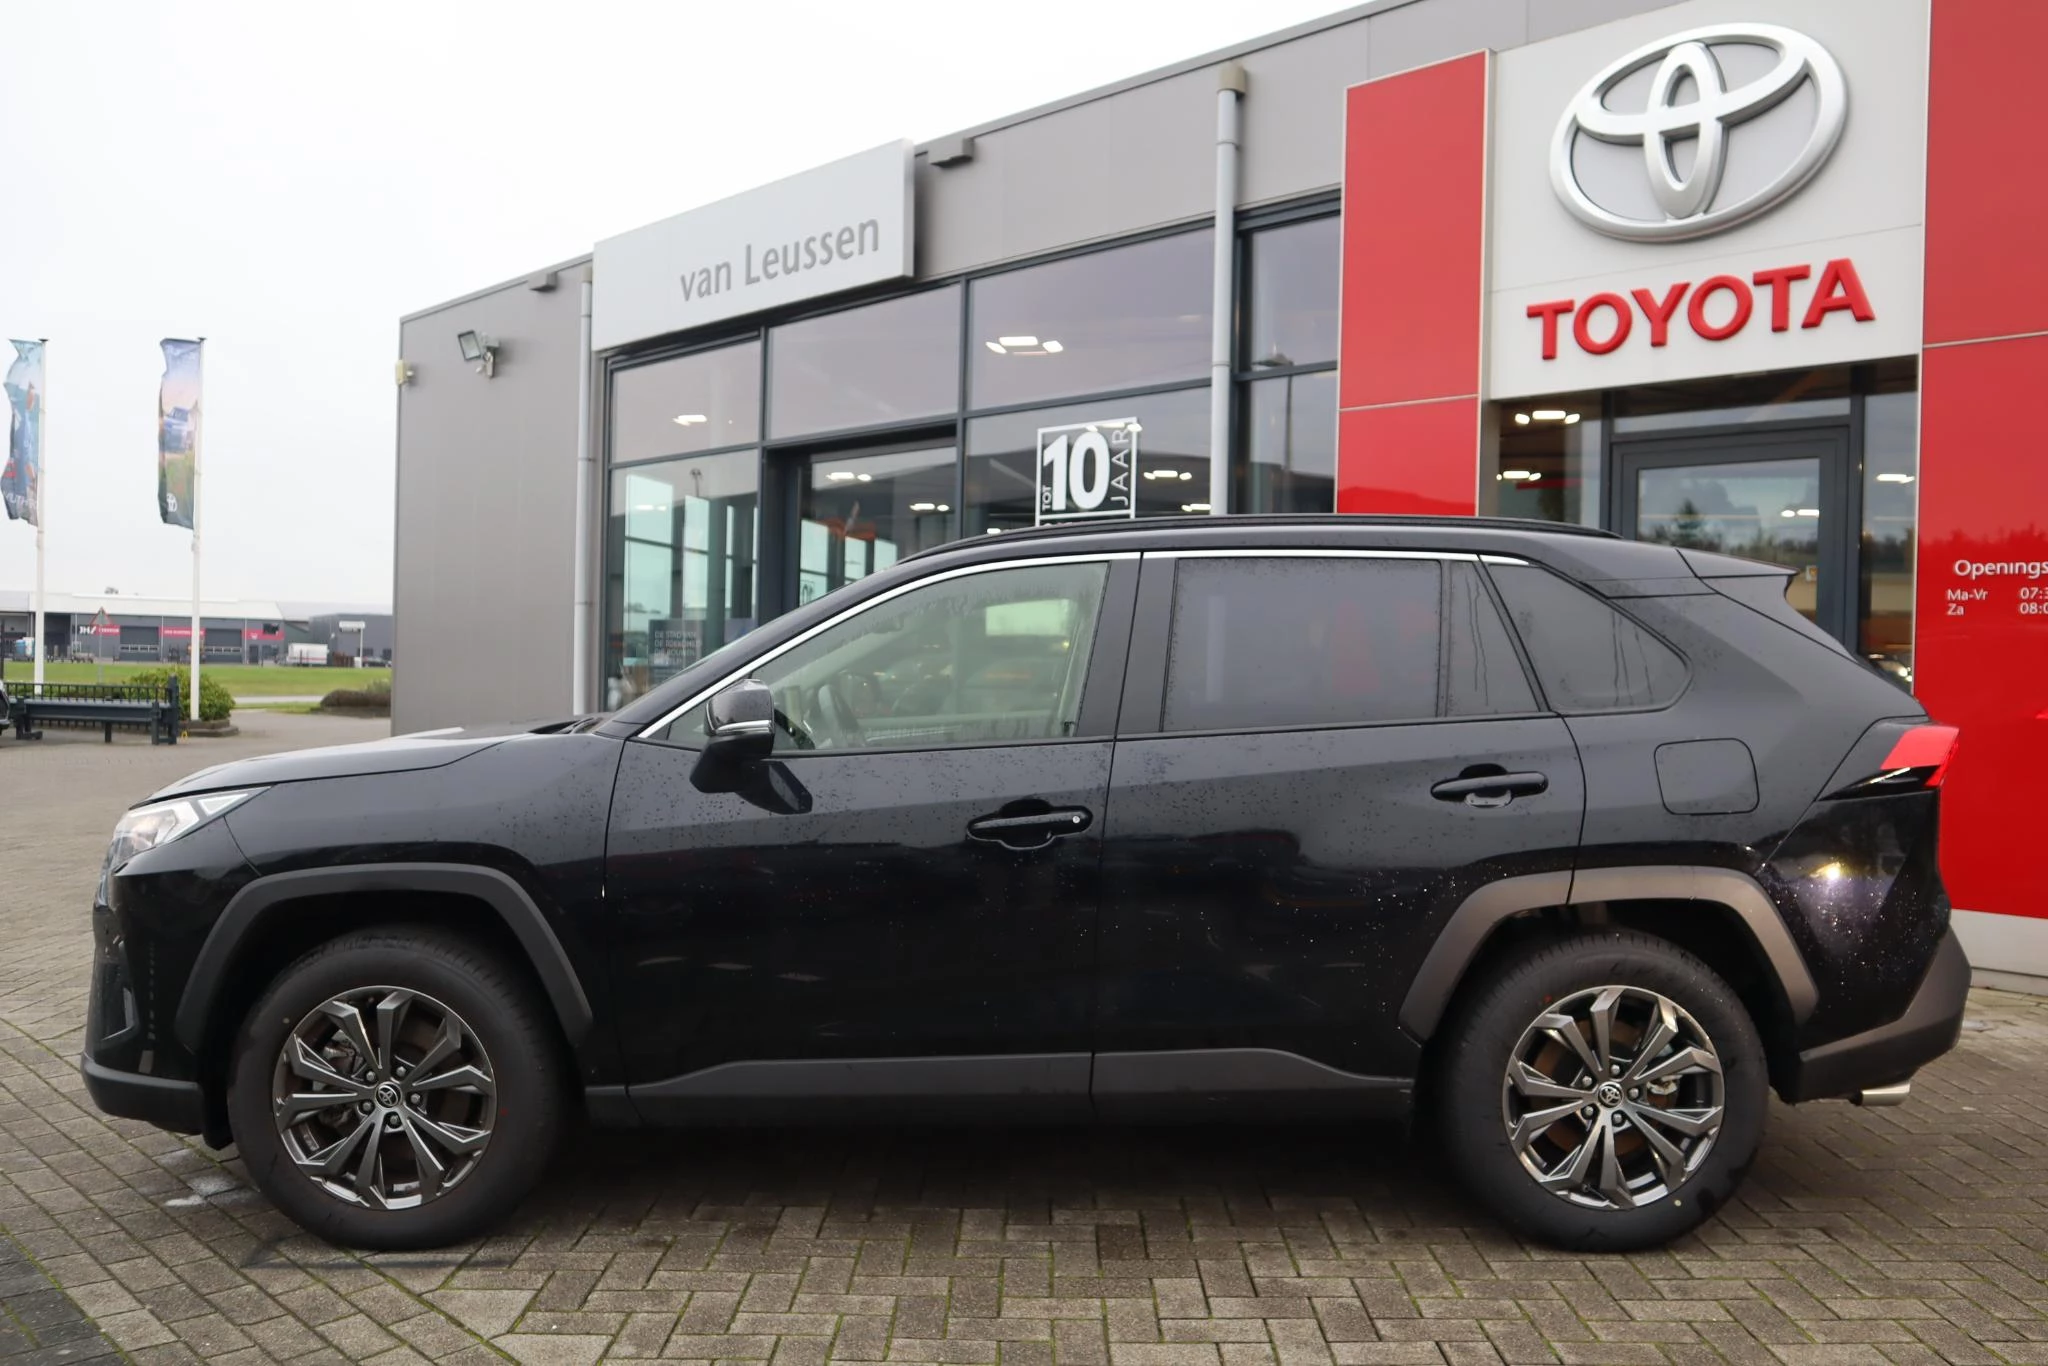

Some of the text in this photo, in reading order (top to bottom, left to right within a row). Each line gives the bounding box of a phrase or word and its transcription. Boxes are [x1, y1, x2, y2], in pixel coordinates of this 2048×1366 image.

[680, 218, 880, 302] van Leussen
[1527, 257, 1876, 360] TOYOTA
[1042, 428, 1129, 512] TOT 10 JAAR
[1946, 588, 1988, 601] Ma-Vr
[1954, 559, 2048, 580] Openings
[1946, 603, 1965, 616] Za
